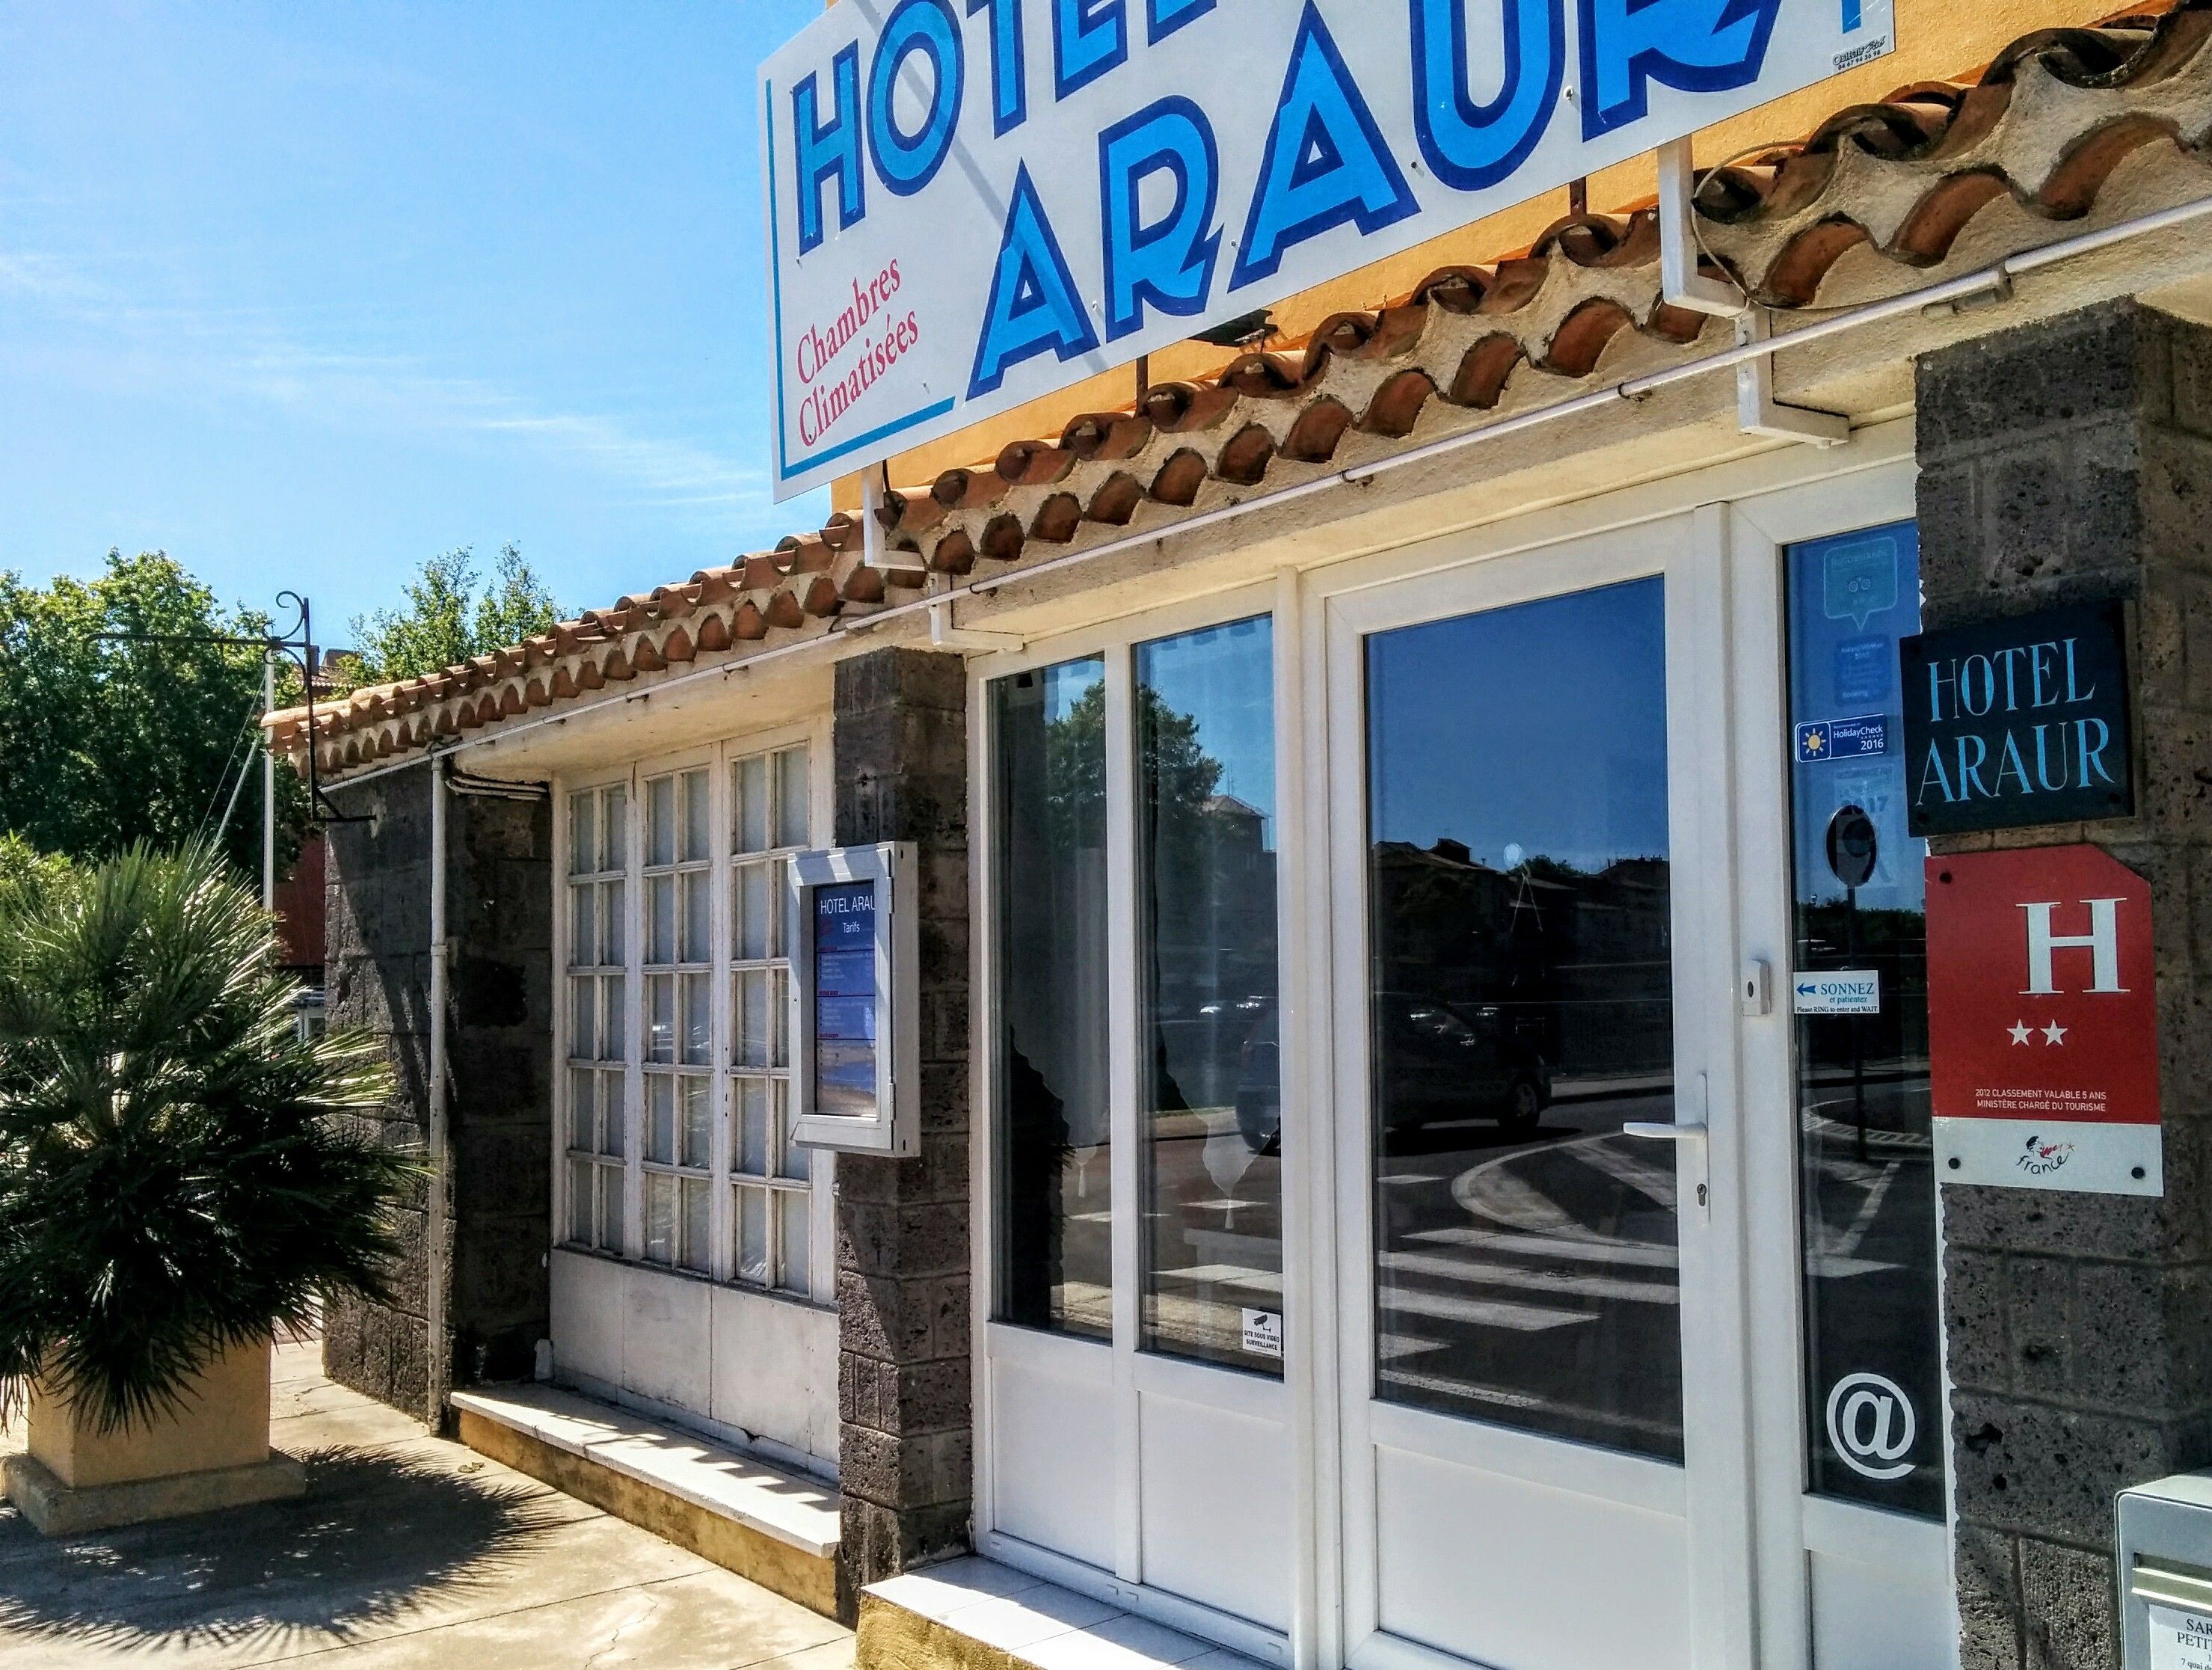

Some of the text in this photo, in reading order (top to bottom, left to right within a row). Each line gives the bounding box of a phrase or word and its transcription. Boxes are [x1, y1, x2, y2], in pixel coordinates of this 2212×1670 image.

[793, 0, 1217, 256] HOT
[797, 259, 900, 384] Chambres
[799, 311, 918, 446] Climatisées
[1928, 637, 2095, 722] HOTEL
[1834, 725, 1883, 738] HolidayCheck
[1861, 738, 1884, 751] 2016
[1915, 717, 2115, 806] ARAUR
[820, 897, 850, 914] HOTEL
[843, 921, 861, 933] Tarifs
[2016, 898, 2130, 995] H
[1820, 982, 1875, 995] SONNEZ
[1837, 996, 1867, 1005] patientez
[1975, 1088, 2107, 1100] 2012 CLASSEMENT VALABLE 5 ANS
[1976, 1099, 2106, 1112] MINISTÈRE CHARGÉ DU TOURISME
[1246, 1339, 1278, 1351] SURVEILLANCE
[1826, 1372, 1917, 1480] @
[2181, 1657, 2186, 1666] 7
[2187, 1661, 2203, 1670] quai
